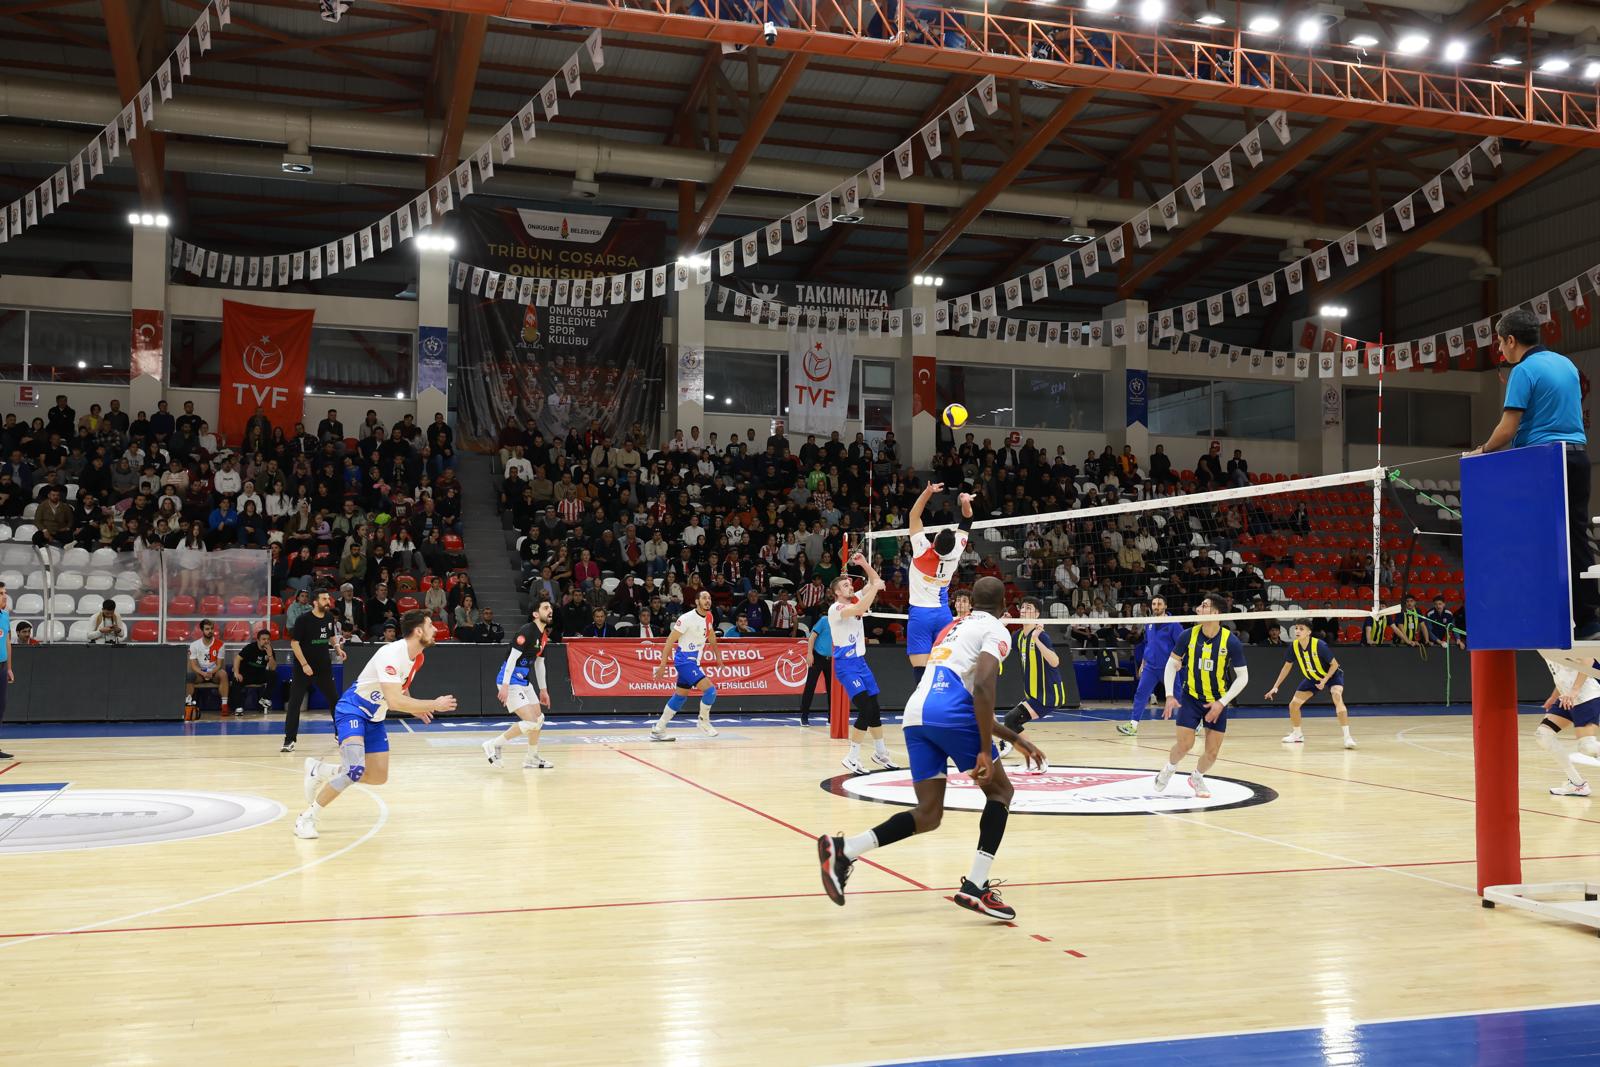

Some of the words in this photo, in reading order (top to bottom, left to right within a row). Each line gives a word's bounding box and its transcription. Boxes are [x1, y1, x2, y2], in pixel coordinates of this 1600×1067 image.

[487, 243, 552, 261] TRİBÜN
[559, 250, 639, 268] COŞARSA
[795, 284, 888, 307] TAKIMIMIZA
[549, 325, 575, 335] SPOR
[20, 386, 33, 401] E
[232, 381, 289, 409] TVF
[794, 384, 836, 409] TVF
[939, 562, 945, 574] 1
[703, 649, 765, 661] OLEYBOL
[716, 680, 768, 690] TEMSİLCİLİĞİ
[852, 679, 862, 688] 16
[518, 692, 525, 700] 3
[348, 719, 359, 729] 10
